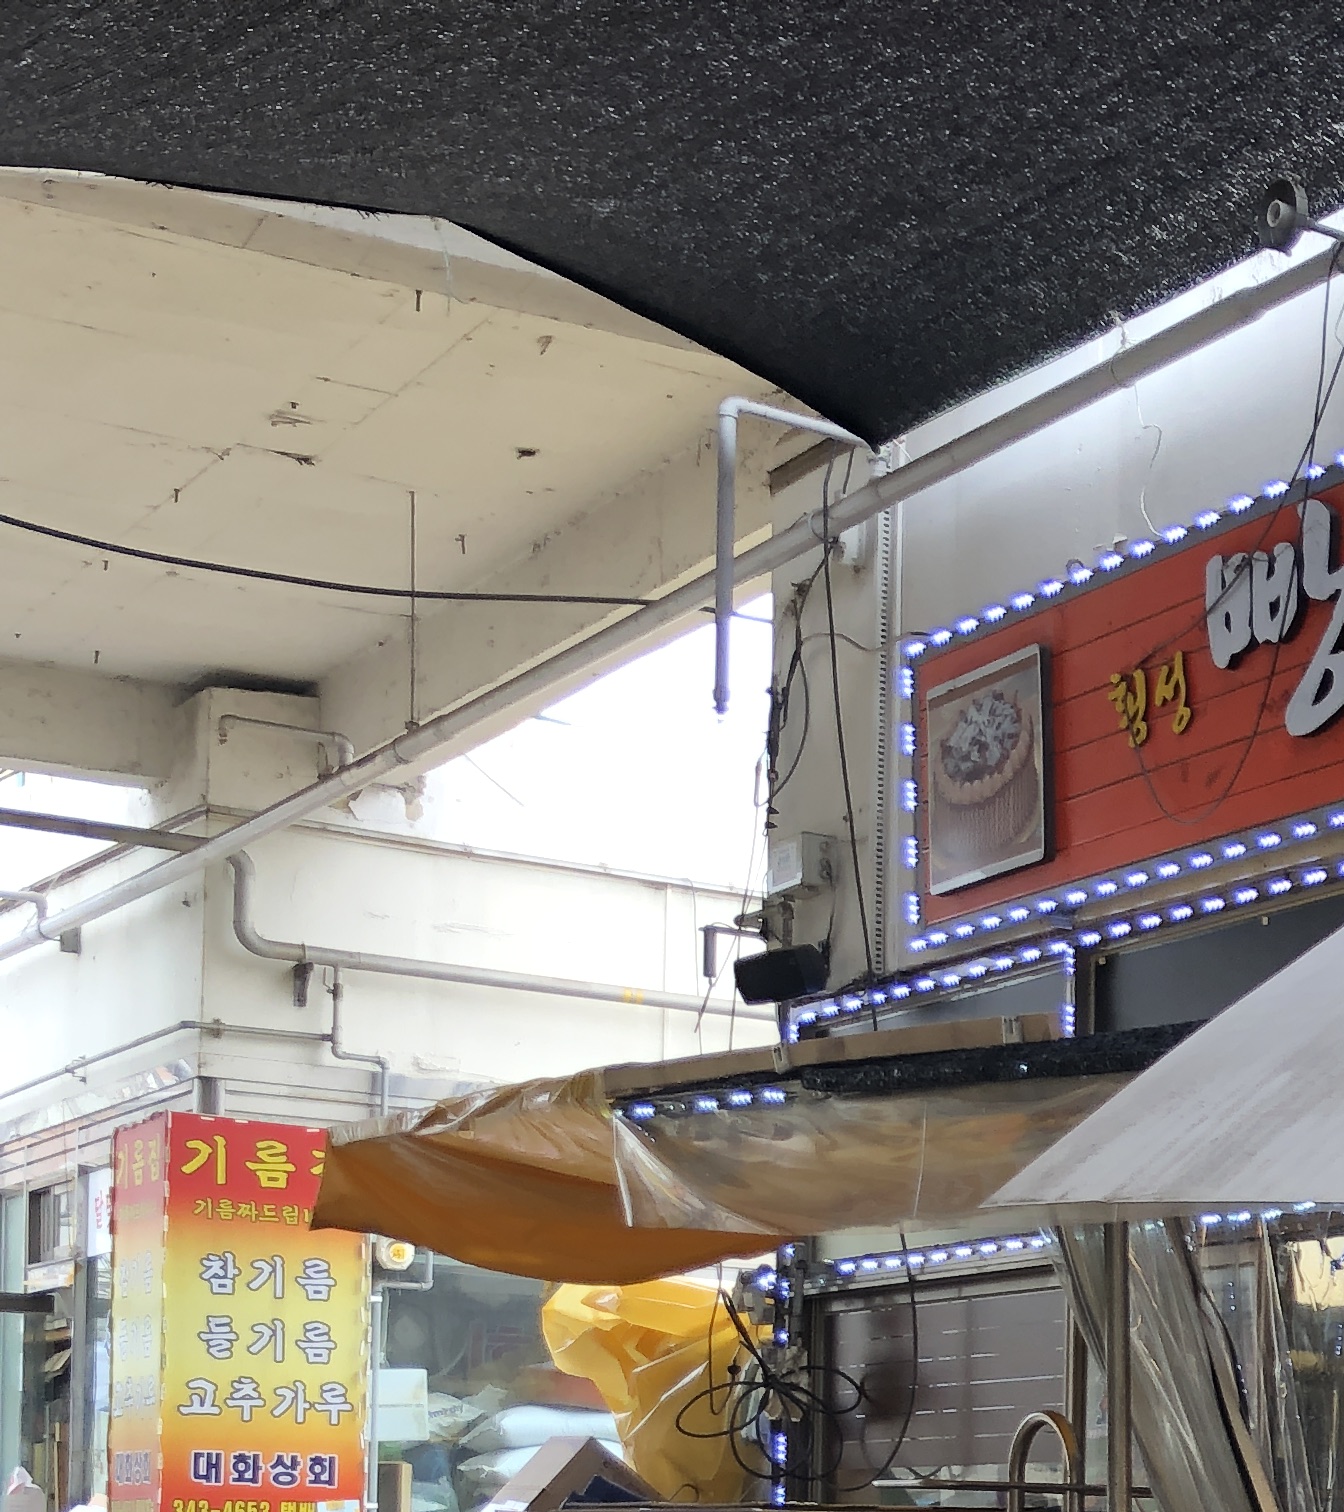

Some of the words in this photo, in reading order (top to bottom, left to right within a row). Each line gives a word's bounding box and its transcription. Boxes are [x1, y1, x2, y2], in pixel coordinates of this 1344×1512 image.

[1107, 650, 1191, 748] 횡성
[199, 1251, 337, 1302] 참기름
[197, 1314, 338, 1364] 들기름
[177, 1376, 353, 1425] 고추가루
[190, 1450, 339, 1488] 대화상회
